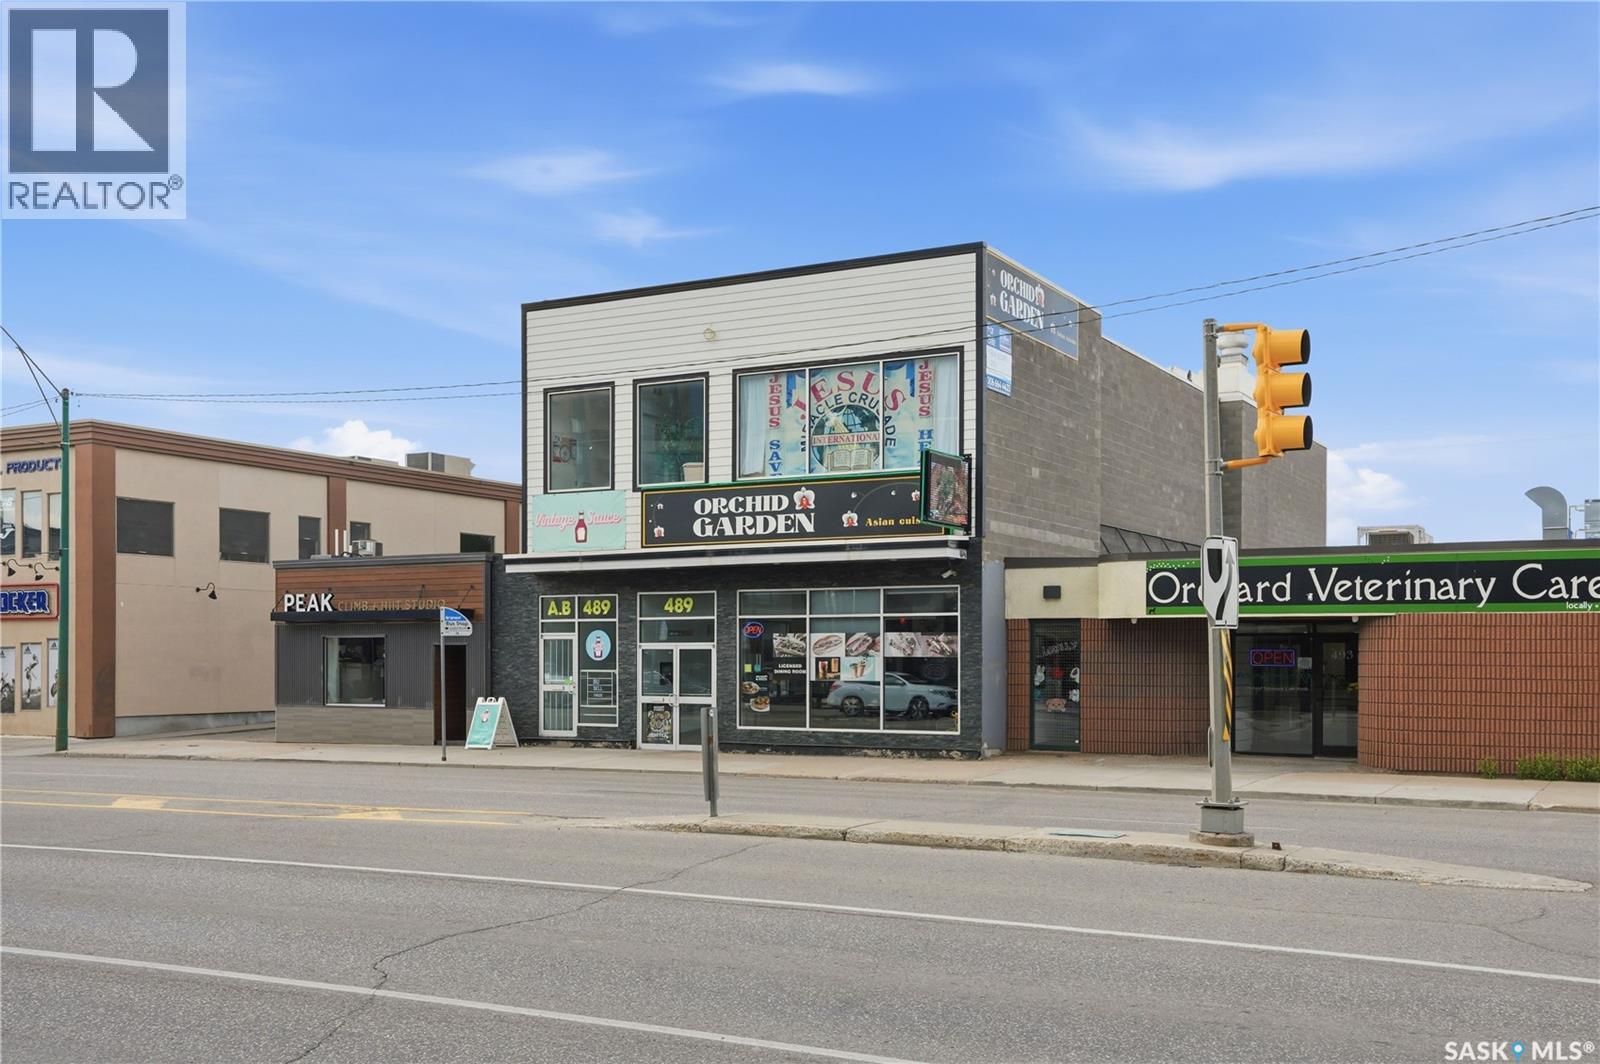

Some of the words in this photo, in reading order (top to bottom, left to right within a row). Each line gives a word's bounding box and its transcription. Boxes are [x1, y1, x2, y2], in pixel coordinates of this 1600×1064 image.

[1000, 269, 1035, 303] ORCHID
[1000, 290, 1044, 330] GARDEN
[918, 359, 932, 417] JESUS
[768, 374, 782, 429] JESUS
[768, 440, 782, 476] SAV
[693, 494, 790, 515] ORCHID
[535, 512, 577, 533] Vintage
[586, 511, 623, 527] Sauce
[692, 513, 815, 538] GARDEN
[865, 517, 895, 527] Asian
[1148, 571, 1291, 604] Orard
[1308, 566, 1496, 608] Veterinary
[1512, 563, 1600, 600] Care
[284, 592, 334, 613] PEAK
[337, 600, 369, 612] CLIMB
[404, 599, 447, 610] STUDIO
[582, 599, 612, 616] 489
[664, 597, 694, 614] 489
[1566, 601, 1593, 611] locally
[744, 625, 764, 635] OPEN
[1253, 651, 1294, 665] OPEN
